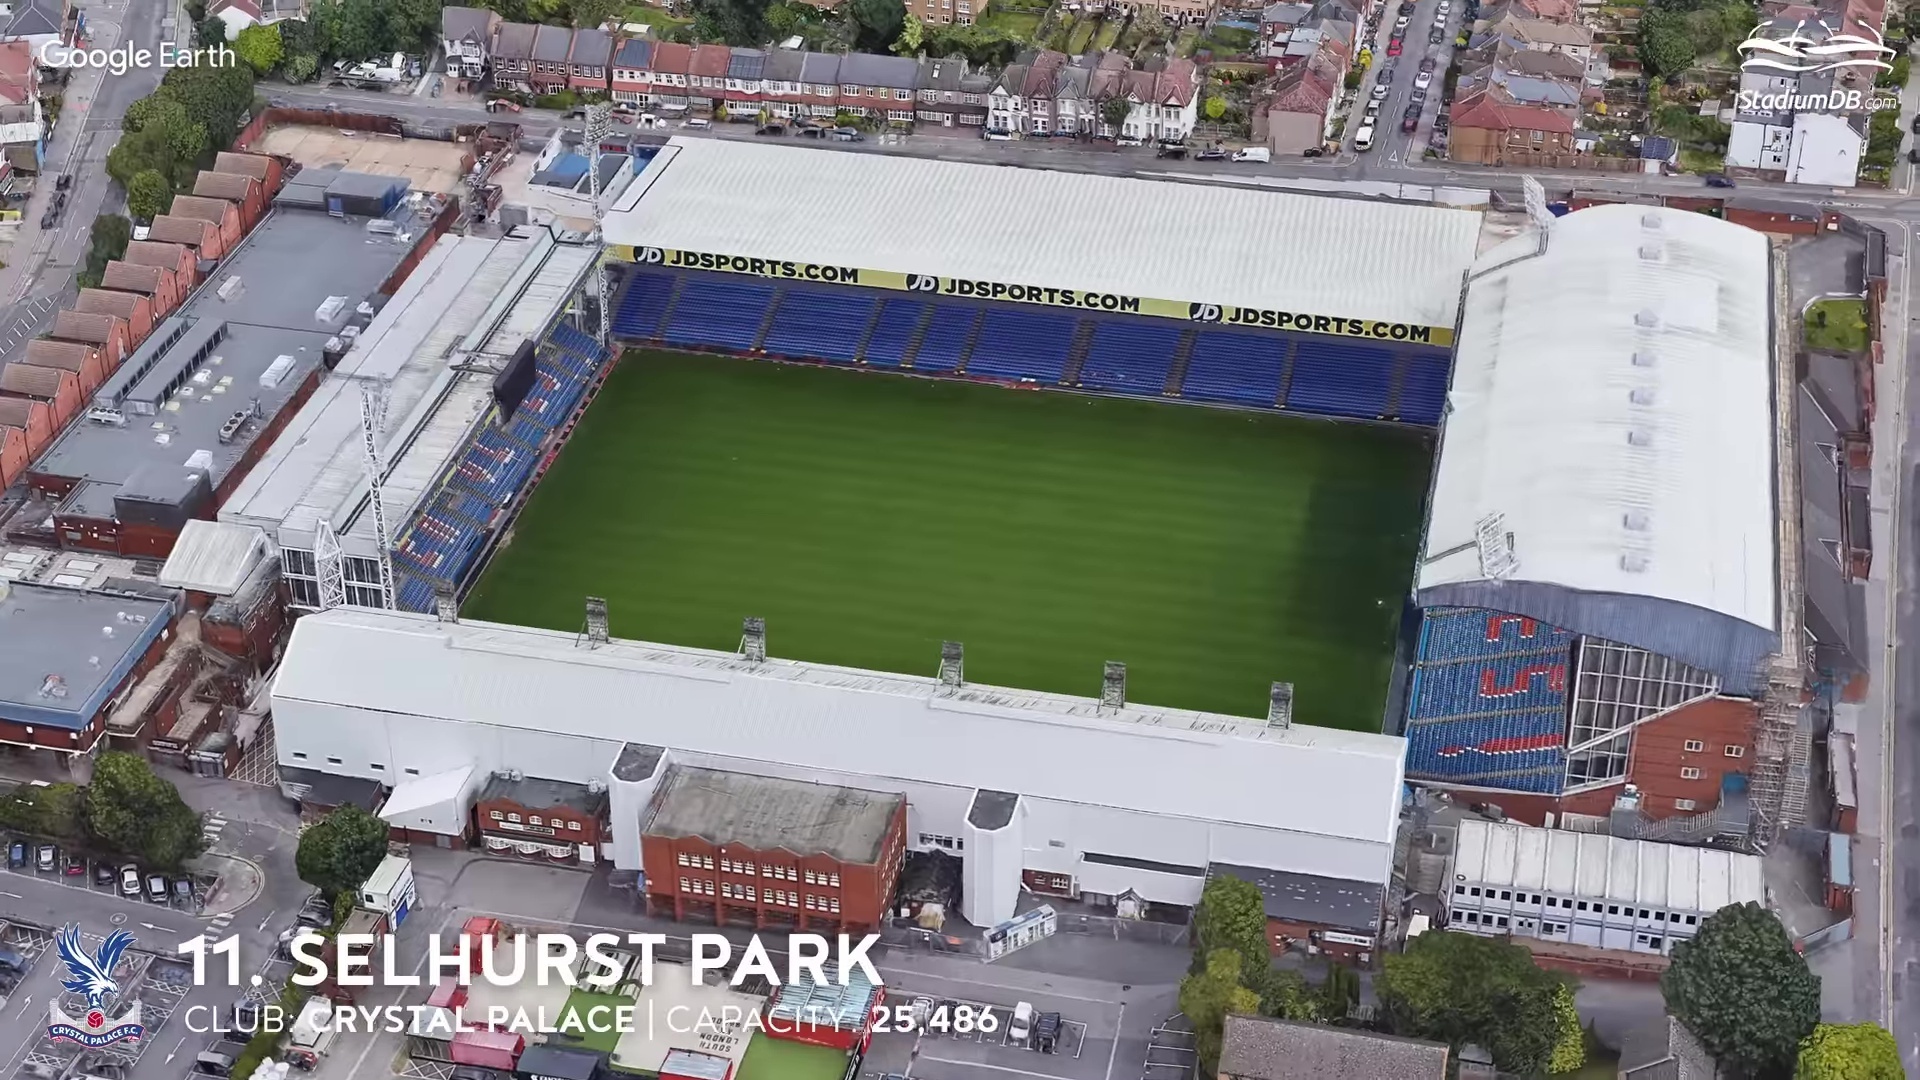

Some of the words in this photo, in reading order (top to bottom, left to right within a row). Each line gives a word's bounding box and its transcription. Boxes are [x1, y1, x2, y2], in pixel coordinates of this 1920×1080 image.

[637, 247, 662, 263] JD
[671, 250, 859, 284] JDSPORTS.COM
[910, 275, 936, 292] JD
[945, 279, 1140, 312] JDSPORTS.COM
[1193, 304, 1221, 321] JD
[1228, 308, 1431, 342] JDSPORTS.COM
